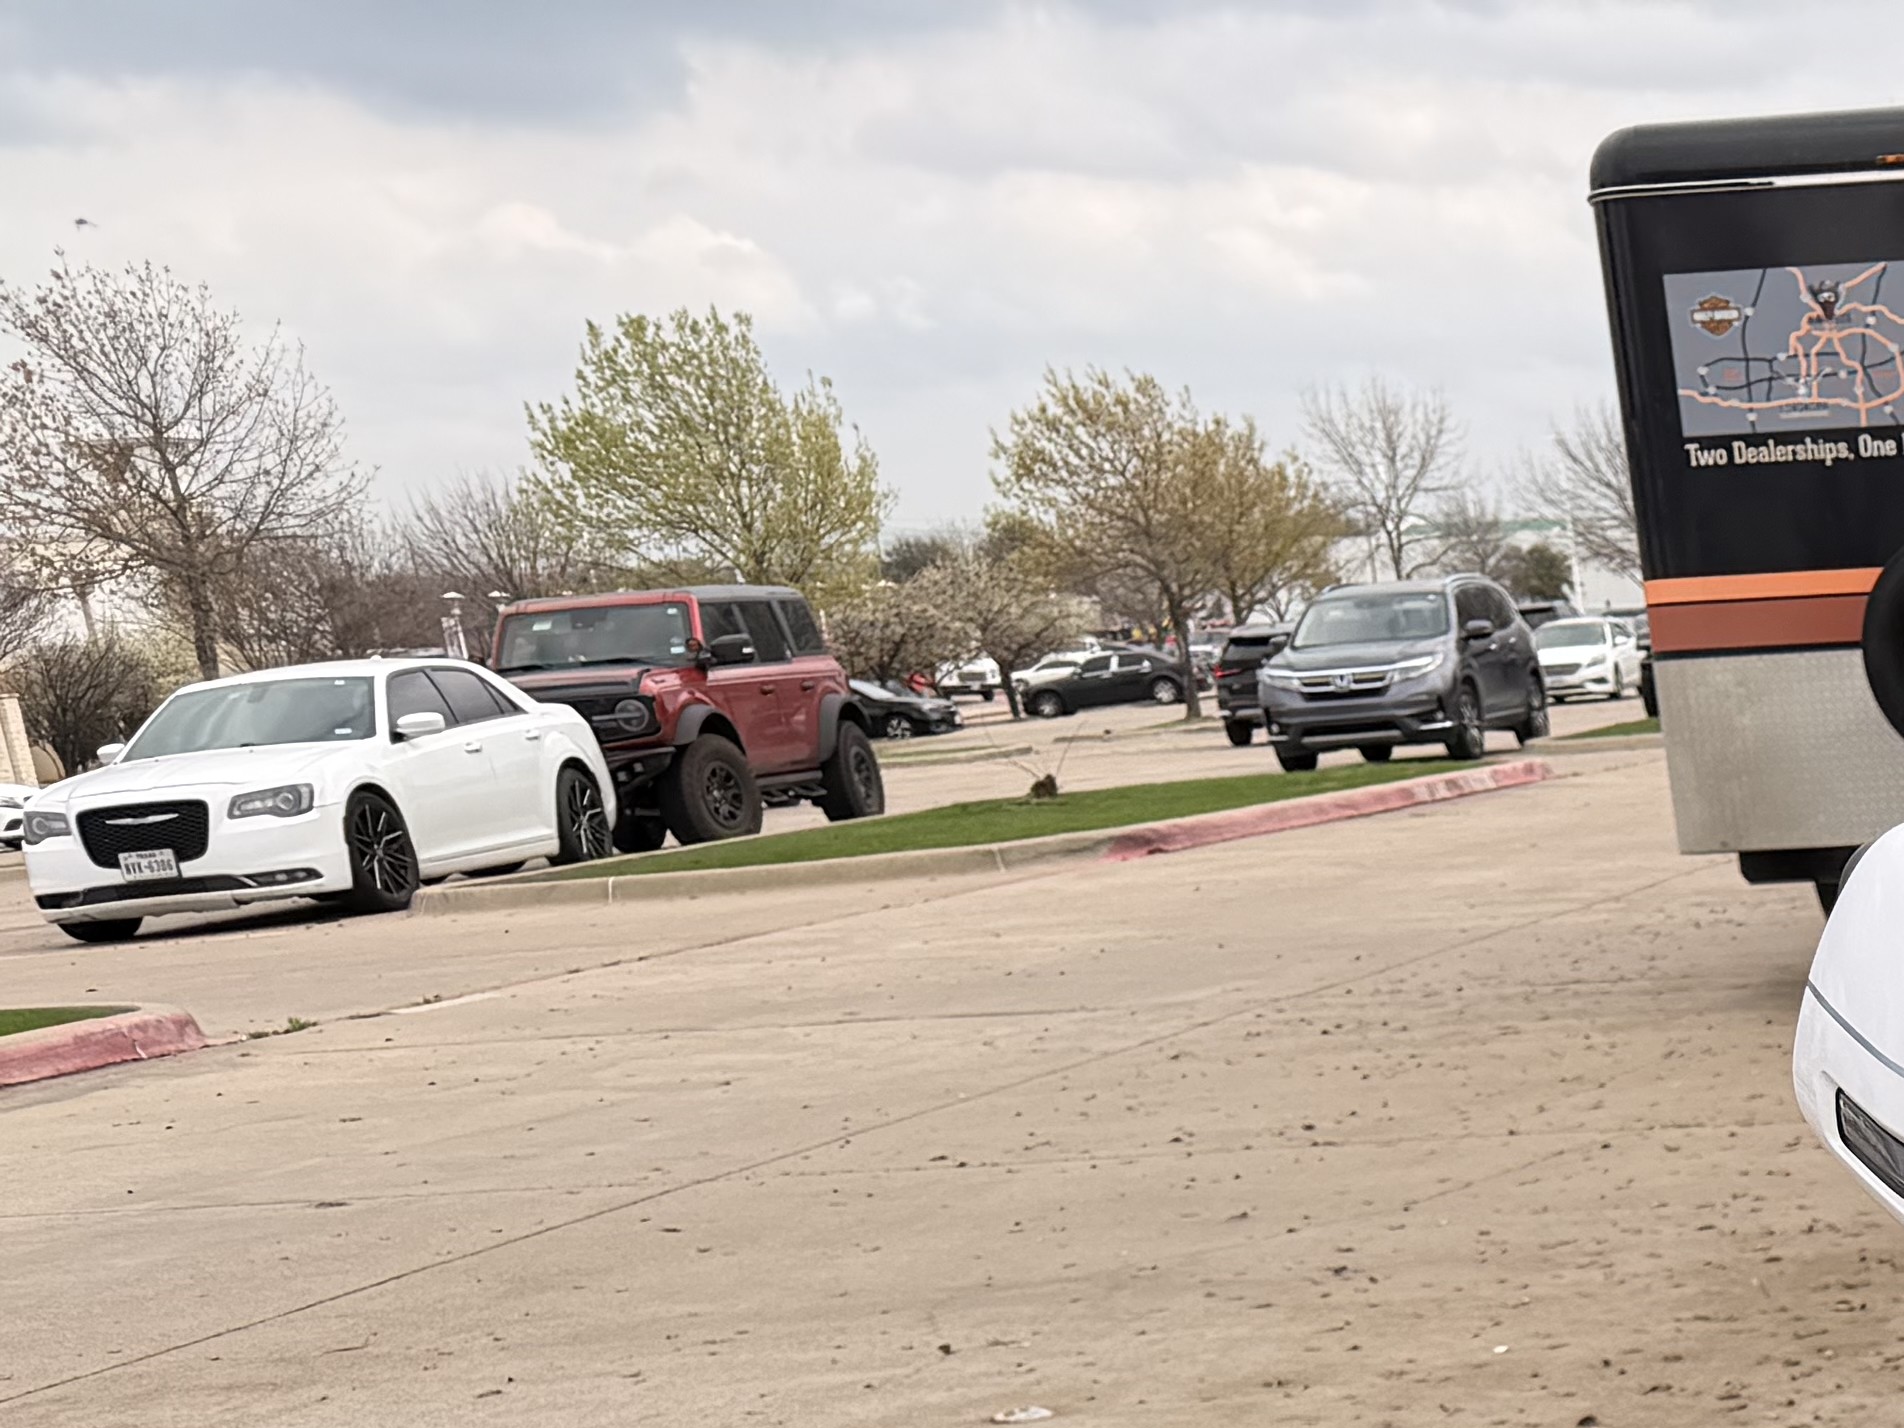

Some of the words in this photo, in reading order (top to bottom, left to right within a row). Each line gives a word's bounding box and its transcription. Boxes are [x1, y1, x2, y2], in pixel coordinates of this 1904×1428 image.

[1685, 442, 1728, 468] Two
[1731, 435, 1855, 466] Dealerships,
[1858, 432, 1897, 457] One
